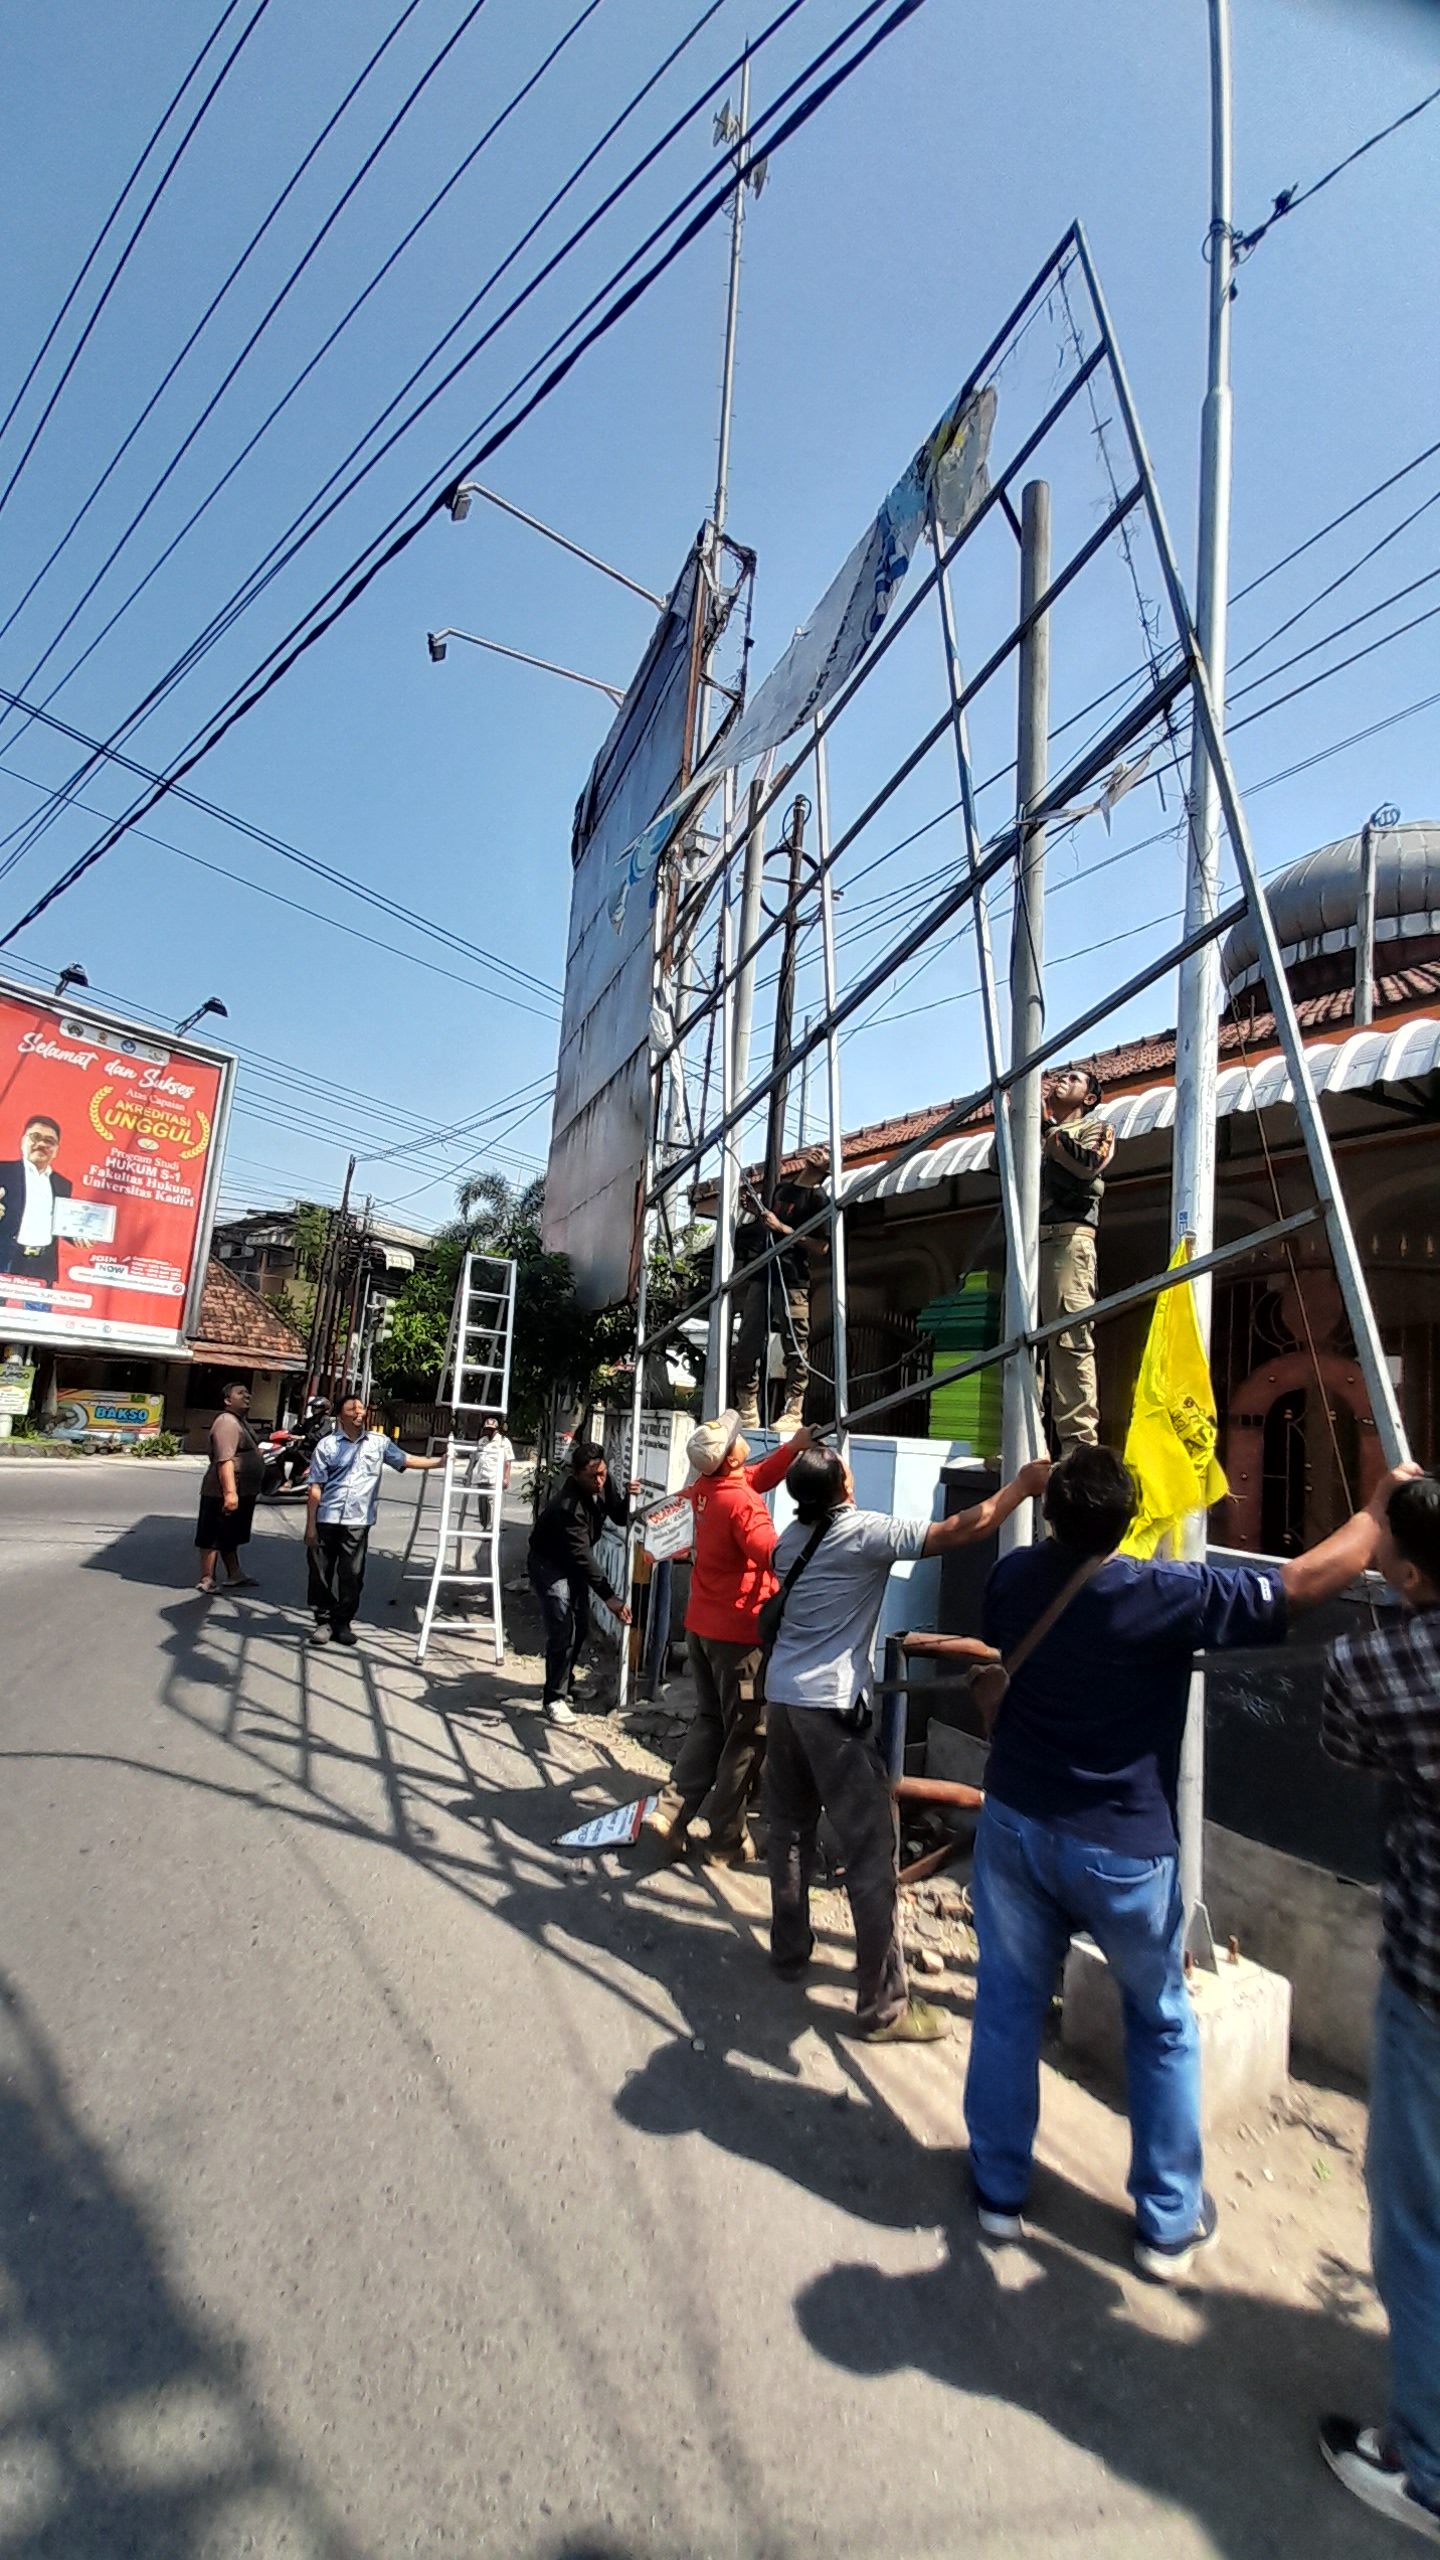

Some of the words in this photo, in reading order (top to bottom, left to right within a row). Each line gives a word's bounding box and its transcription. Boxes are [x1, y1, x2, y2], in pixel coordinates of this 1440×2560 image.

[17, 1032, 99, 1070] Selamat
[104, 1059, 137, 1080] dan
[138, 1068, 195, 1099] Sukses
[104, 1107, 195, 1146] UNGGUL
[115, 1099, 191, 1128] AKREDITASI
[105, 1156, 158, 1177] HUKUM
[160, 1168, 181, 1182] S-1
[110, 1147, 152, 1164] Program
[154, 1157, 180, 1170] Studi
[82, 1174, 153, 1198] Universitas
[155, 1190, 195, 1208] Kadiri
[89, 1164, 143, 1185] Fakultas
[146, 1176, 192, 1195] Hukum
[90, 1254, 118, 1263] JOIN
[99, 1264, 125, 1274] NOW
[95, 1406, 149, 1421] BAKSO
